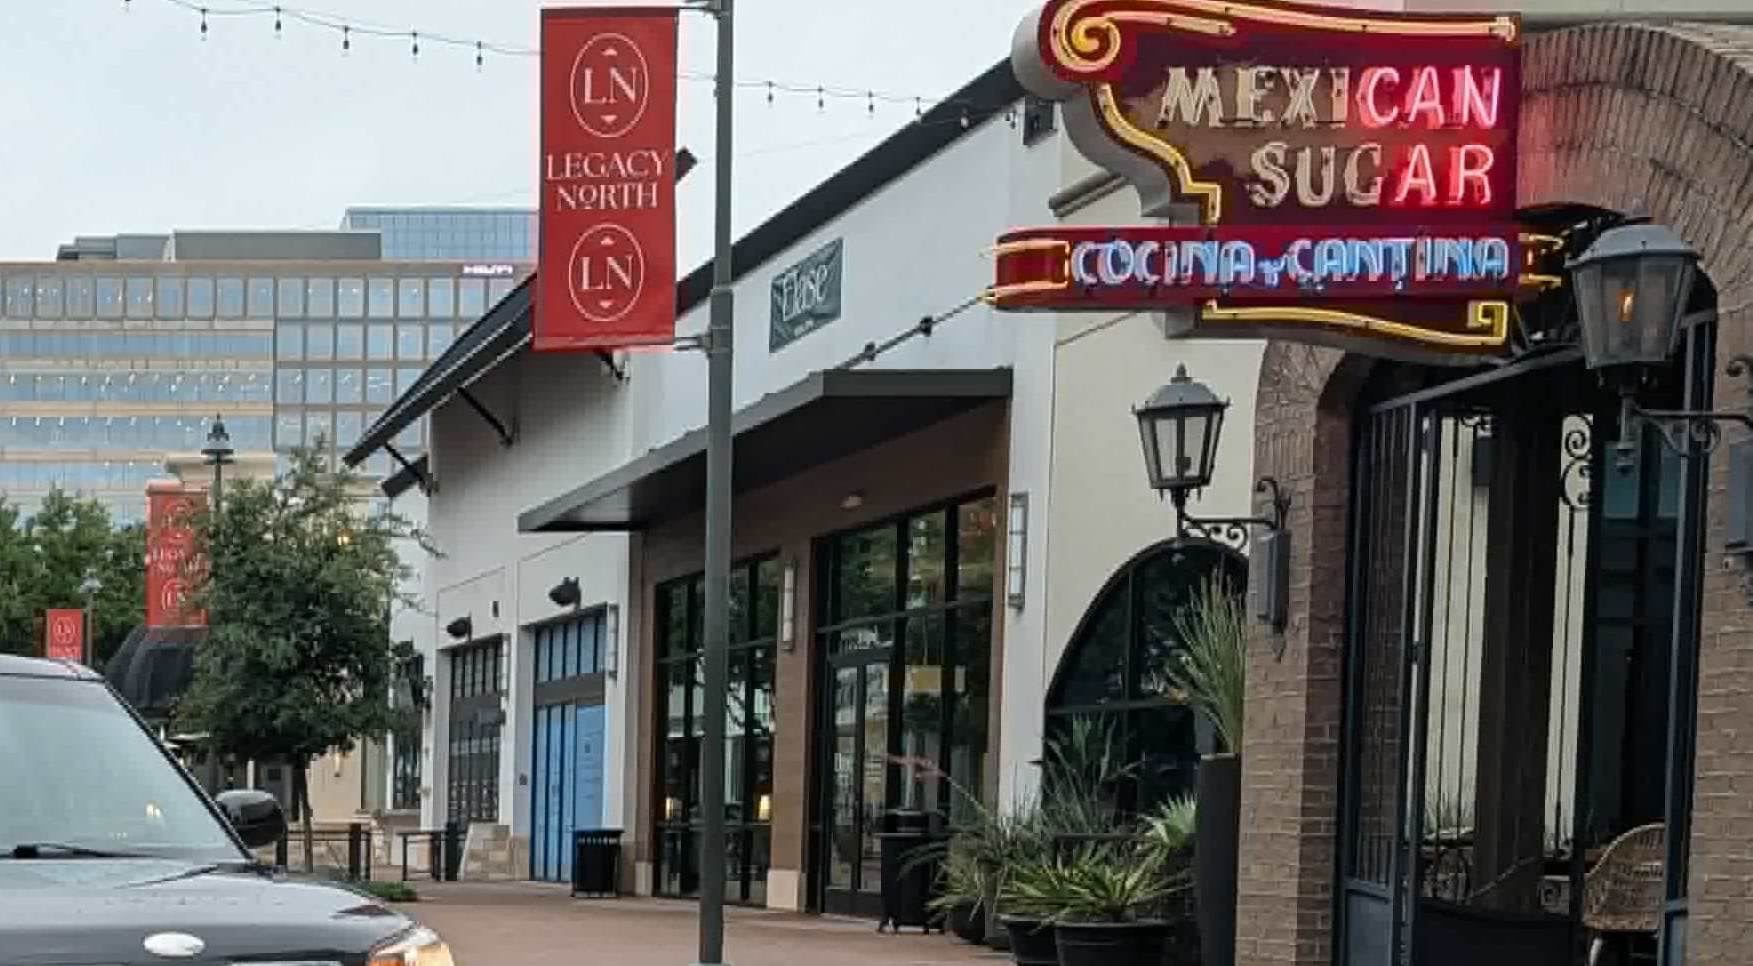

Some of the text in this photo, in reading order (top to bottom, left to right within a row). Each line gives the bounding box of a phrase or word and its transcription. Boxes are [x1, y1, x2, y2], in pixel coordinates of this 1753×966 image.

[584, 67, 637, 105] LN
[1157, 63, 1502, 131] MEXICAN
[546, 150, 668, 182] LEGACY
[1247, 142, 1495, 208] SUGAR
[556, 182, 658, 211] NORTH
[580, 255, 633, 290] LN
[1071, 238, 1255, 286] COCINA
[1285, 236, 1511, 283] CANTINA
